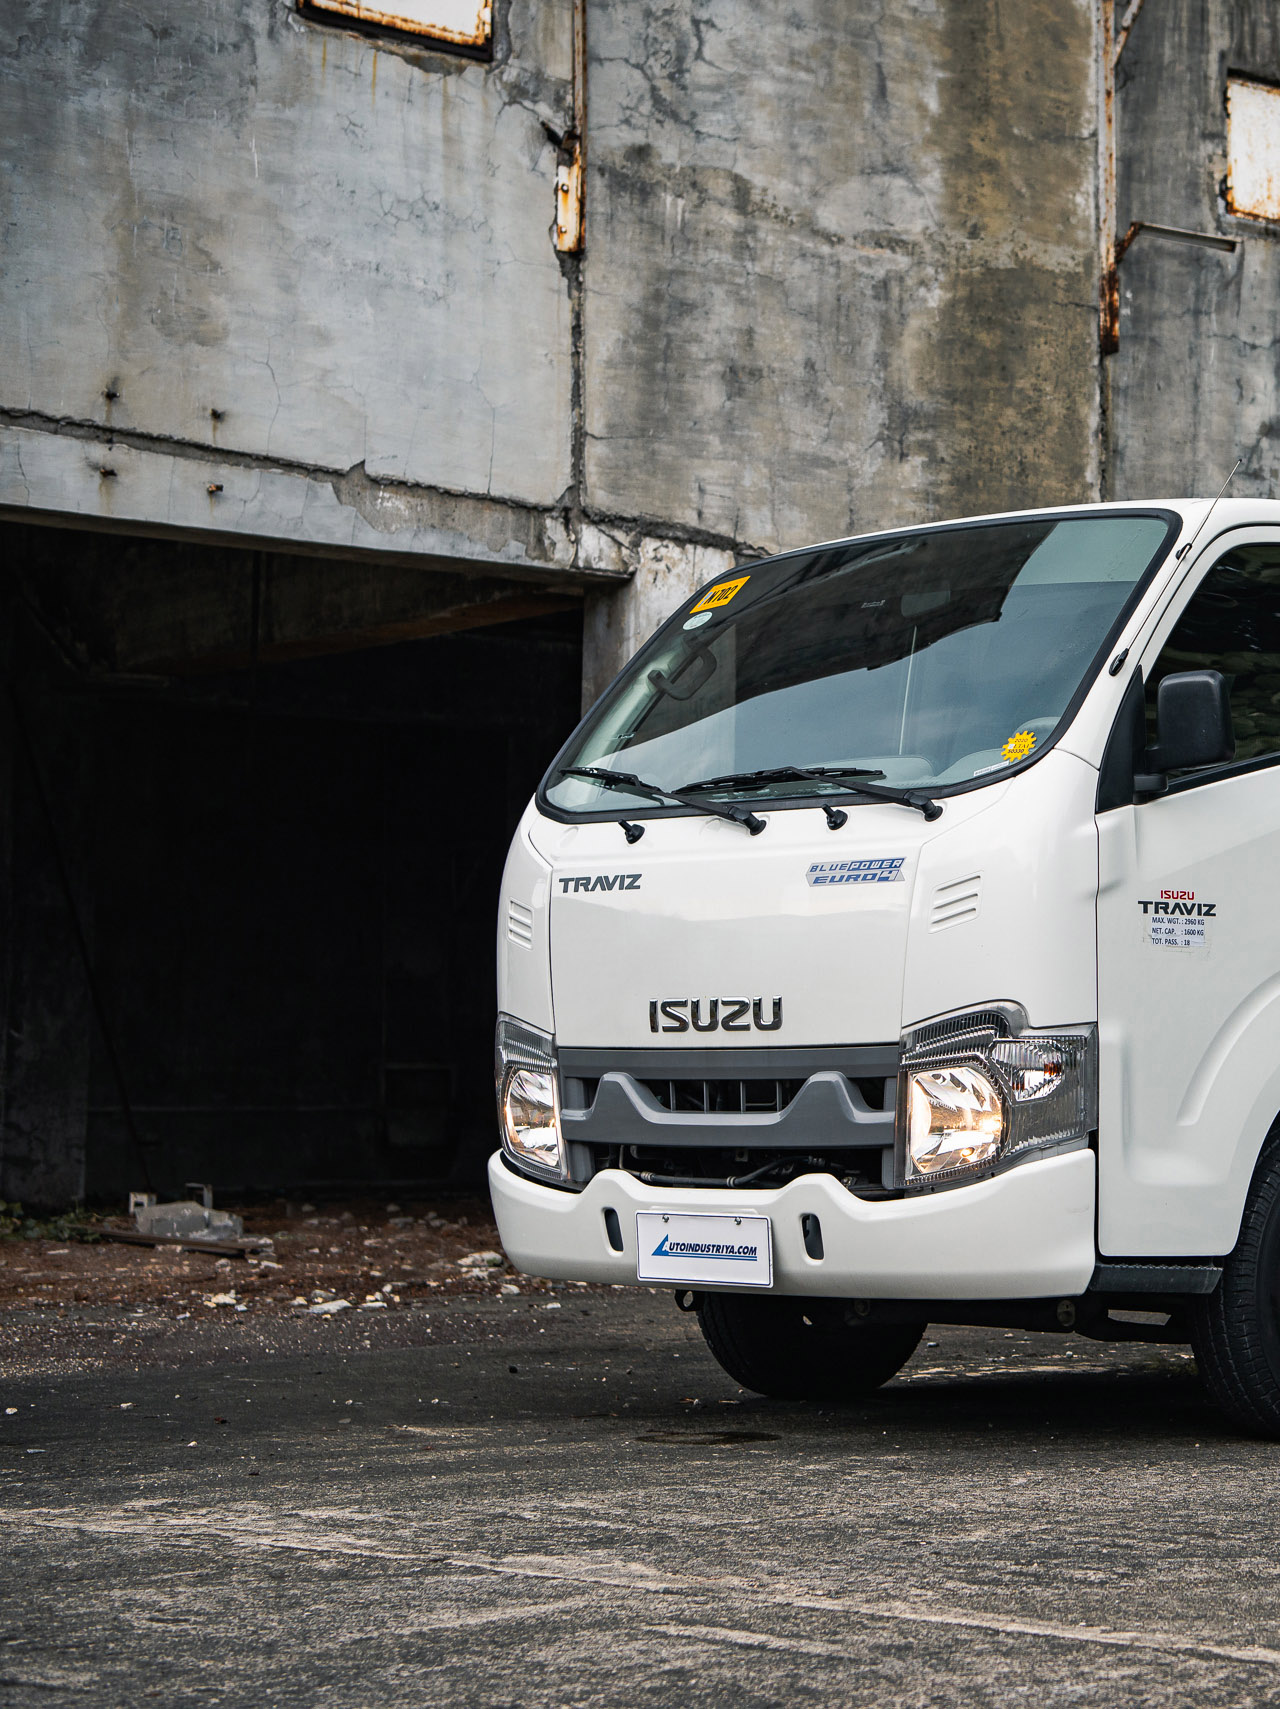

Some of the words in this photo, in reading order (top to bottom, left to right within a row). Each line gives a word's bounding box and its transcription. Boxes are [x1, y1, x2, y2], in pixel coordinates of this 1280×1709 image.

[558, 873, 642, 893] TRAVIZ
[1160, 889, 1195, 900] ISUZU
[1137, 900, 1217, 917] TRAVIZ
[1197, 918, 1205, 926] KG
[648, 994, 783, 1033] ISUZU
[651, 1233, 758, 1256] AUTOINDUSTRIYA.COM
